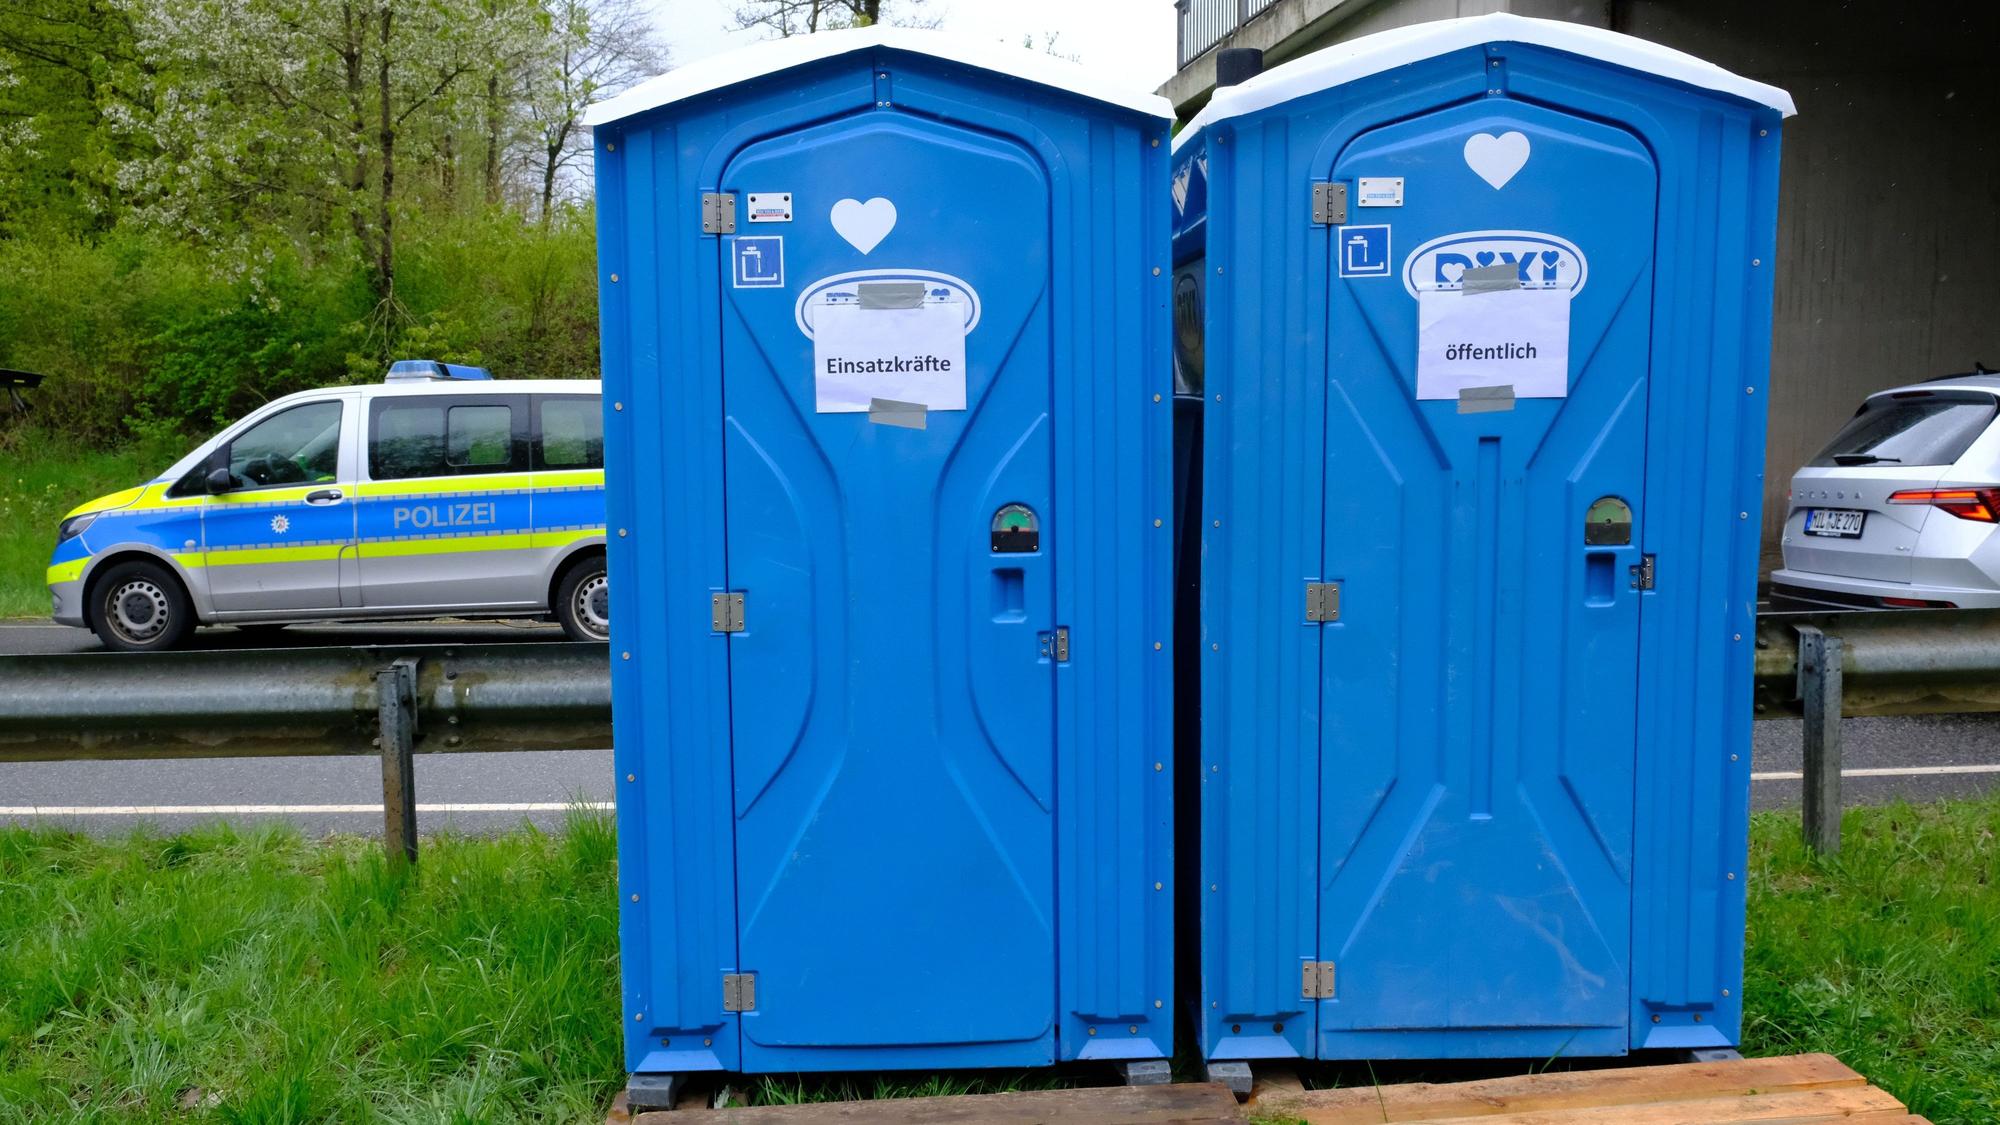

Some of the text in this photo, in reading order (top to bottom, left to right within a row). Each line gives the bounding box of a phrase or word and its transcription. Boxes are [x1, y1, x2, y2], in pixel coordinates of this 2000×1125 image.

[1445, 341, 1537, 361] öffentlich
[827, 354, 951, 374] Einsatzkräfte
[393, 502, 496, 528] POLIZEI
[1843, 514, 1861, 531] 270
